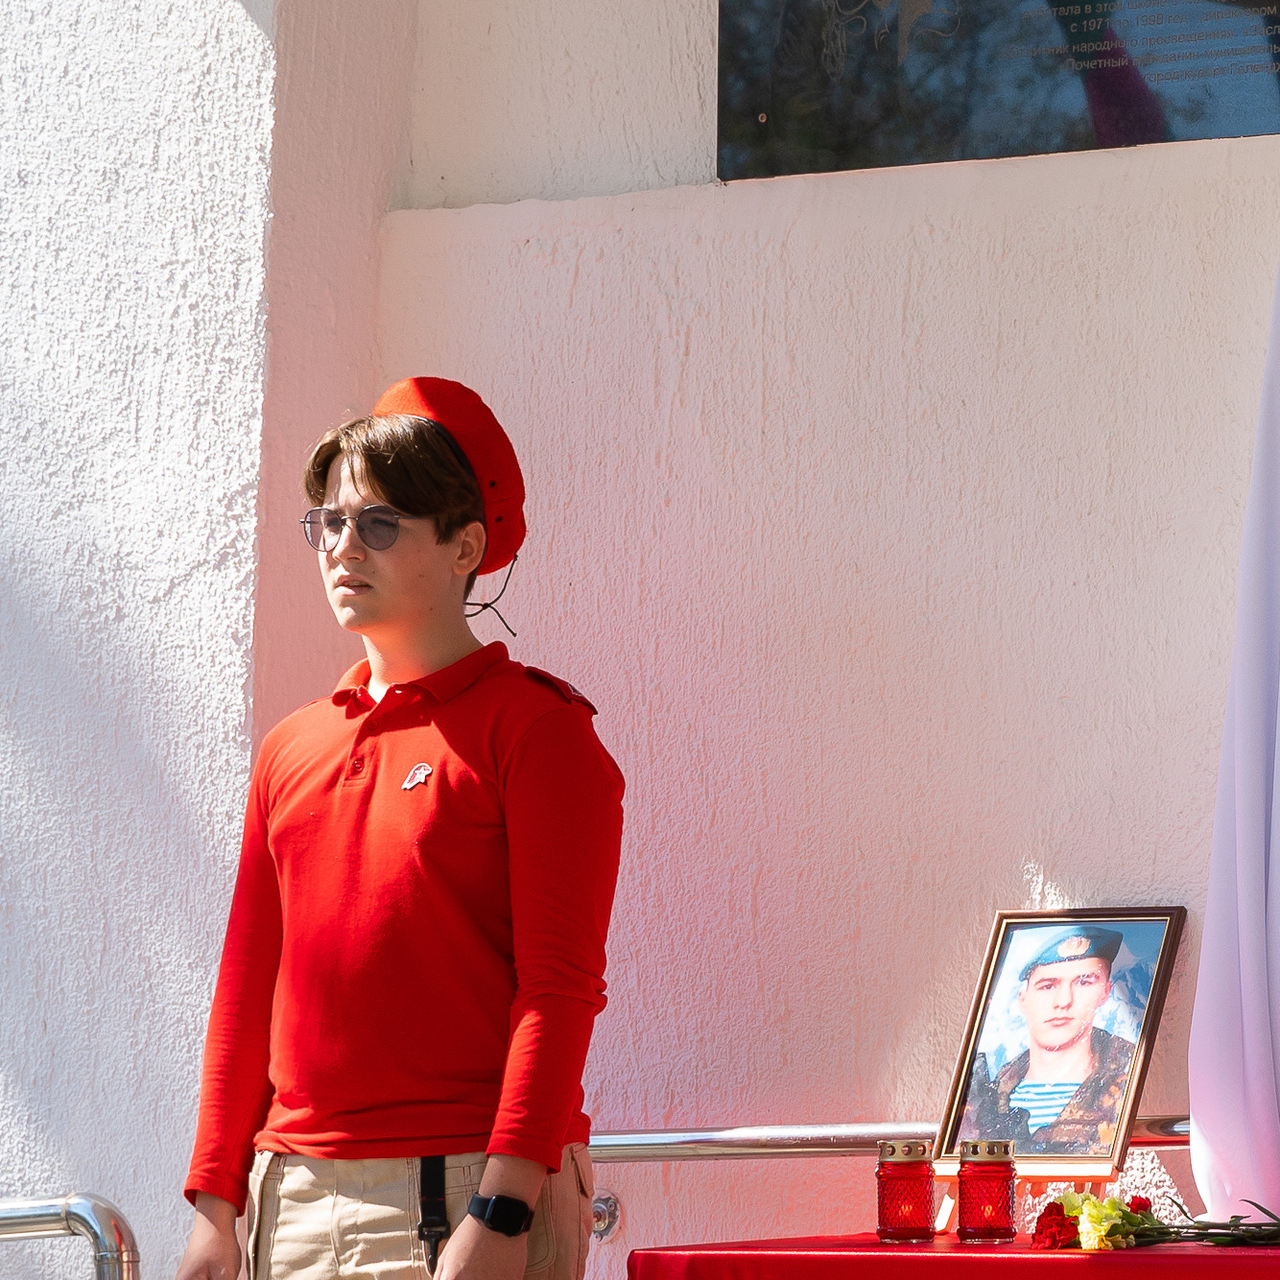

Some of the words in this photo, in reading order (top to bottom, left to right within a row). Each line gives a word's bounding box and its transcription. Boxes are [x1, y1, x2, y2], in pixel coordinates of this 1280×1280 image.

[1084, 4, 1092, 14] в
[1095, 0, 1122, 14] этой
[1070, 23, 1078, 33] с
[1082, 18, 1110, 32] 1971
